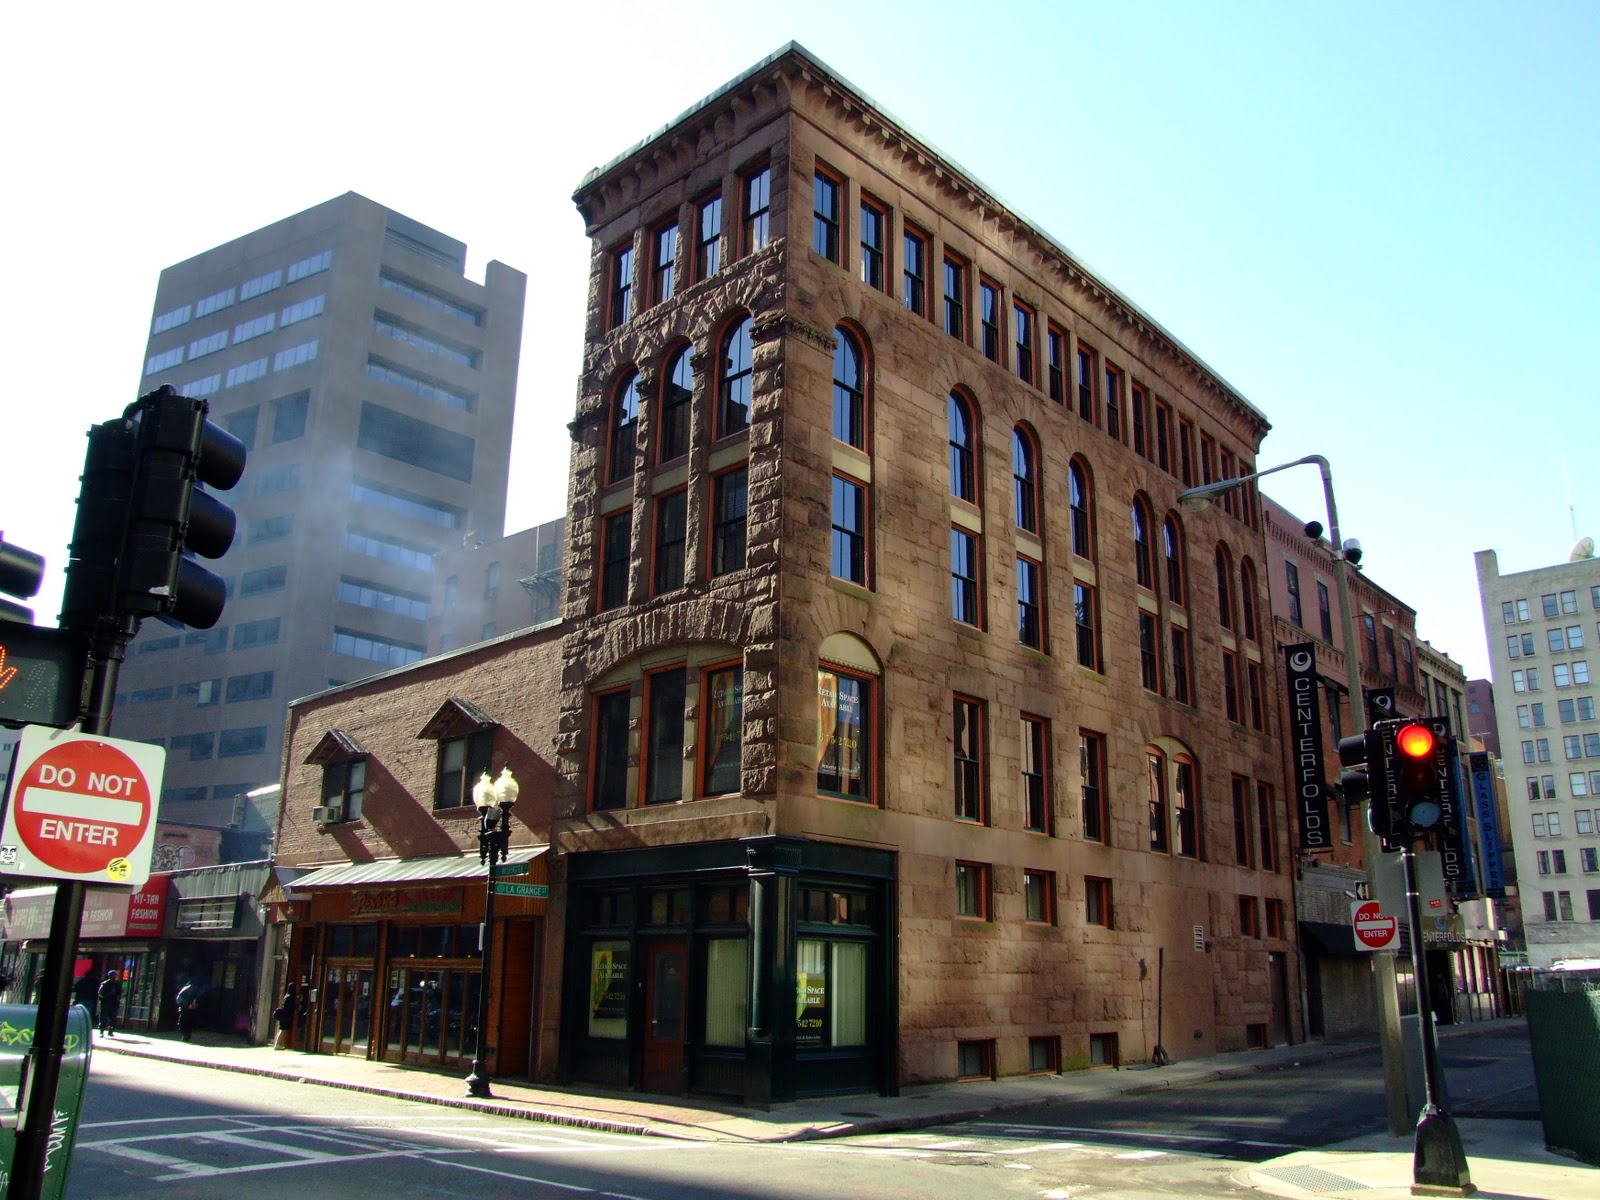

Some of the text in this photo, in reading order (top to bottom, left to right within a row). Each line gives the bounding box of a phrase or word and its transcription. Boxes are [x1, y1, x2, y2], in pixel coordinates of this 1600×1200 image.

[839, 691, 859, 703] SPACE
[1294, 677, 1323, 845] CENTERFOLDS
[39, 764, 137, 796] DO NOT
[39, 818, 118, 846] ENTER
[1476, 772, 1499, 888] GLASS SLIPPER
[505, 885, 515, 893] LA
[516, 886, 542, 896] GRANGE
[131, 908, 159, 920] FASHION
[1358, 912, 1370, 920] DO
[1363, 929, 1388, 938] ENTER
[1423, 931, 1466, 943] ENTERFOLDS
[807, 985, 825, 995] SPACE
